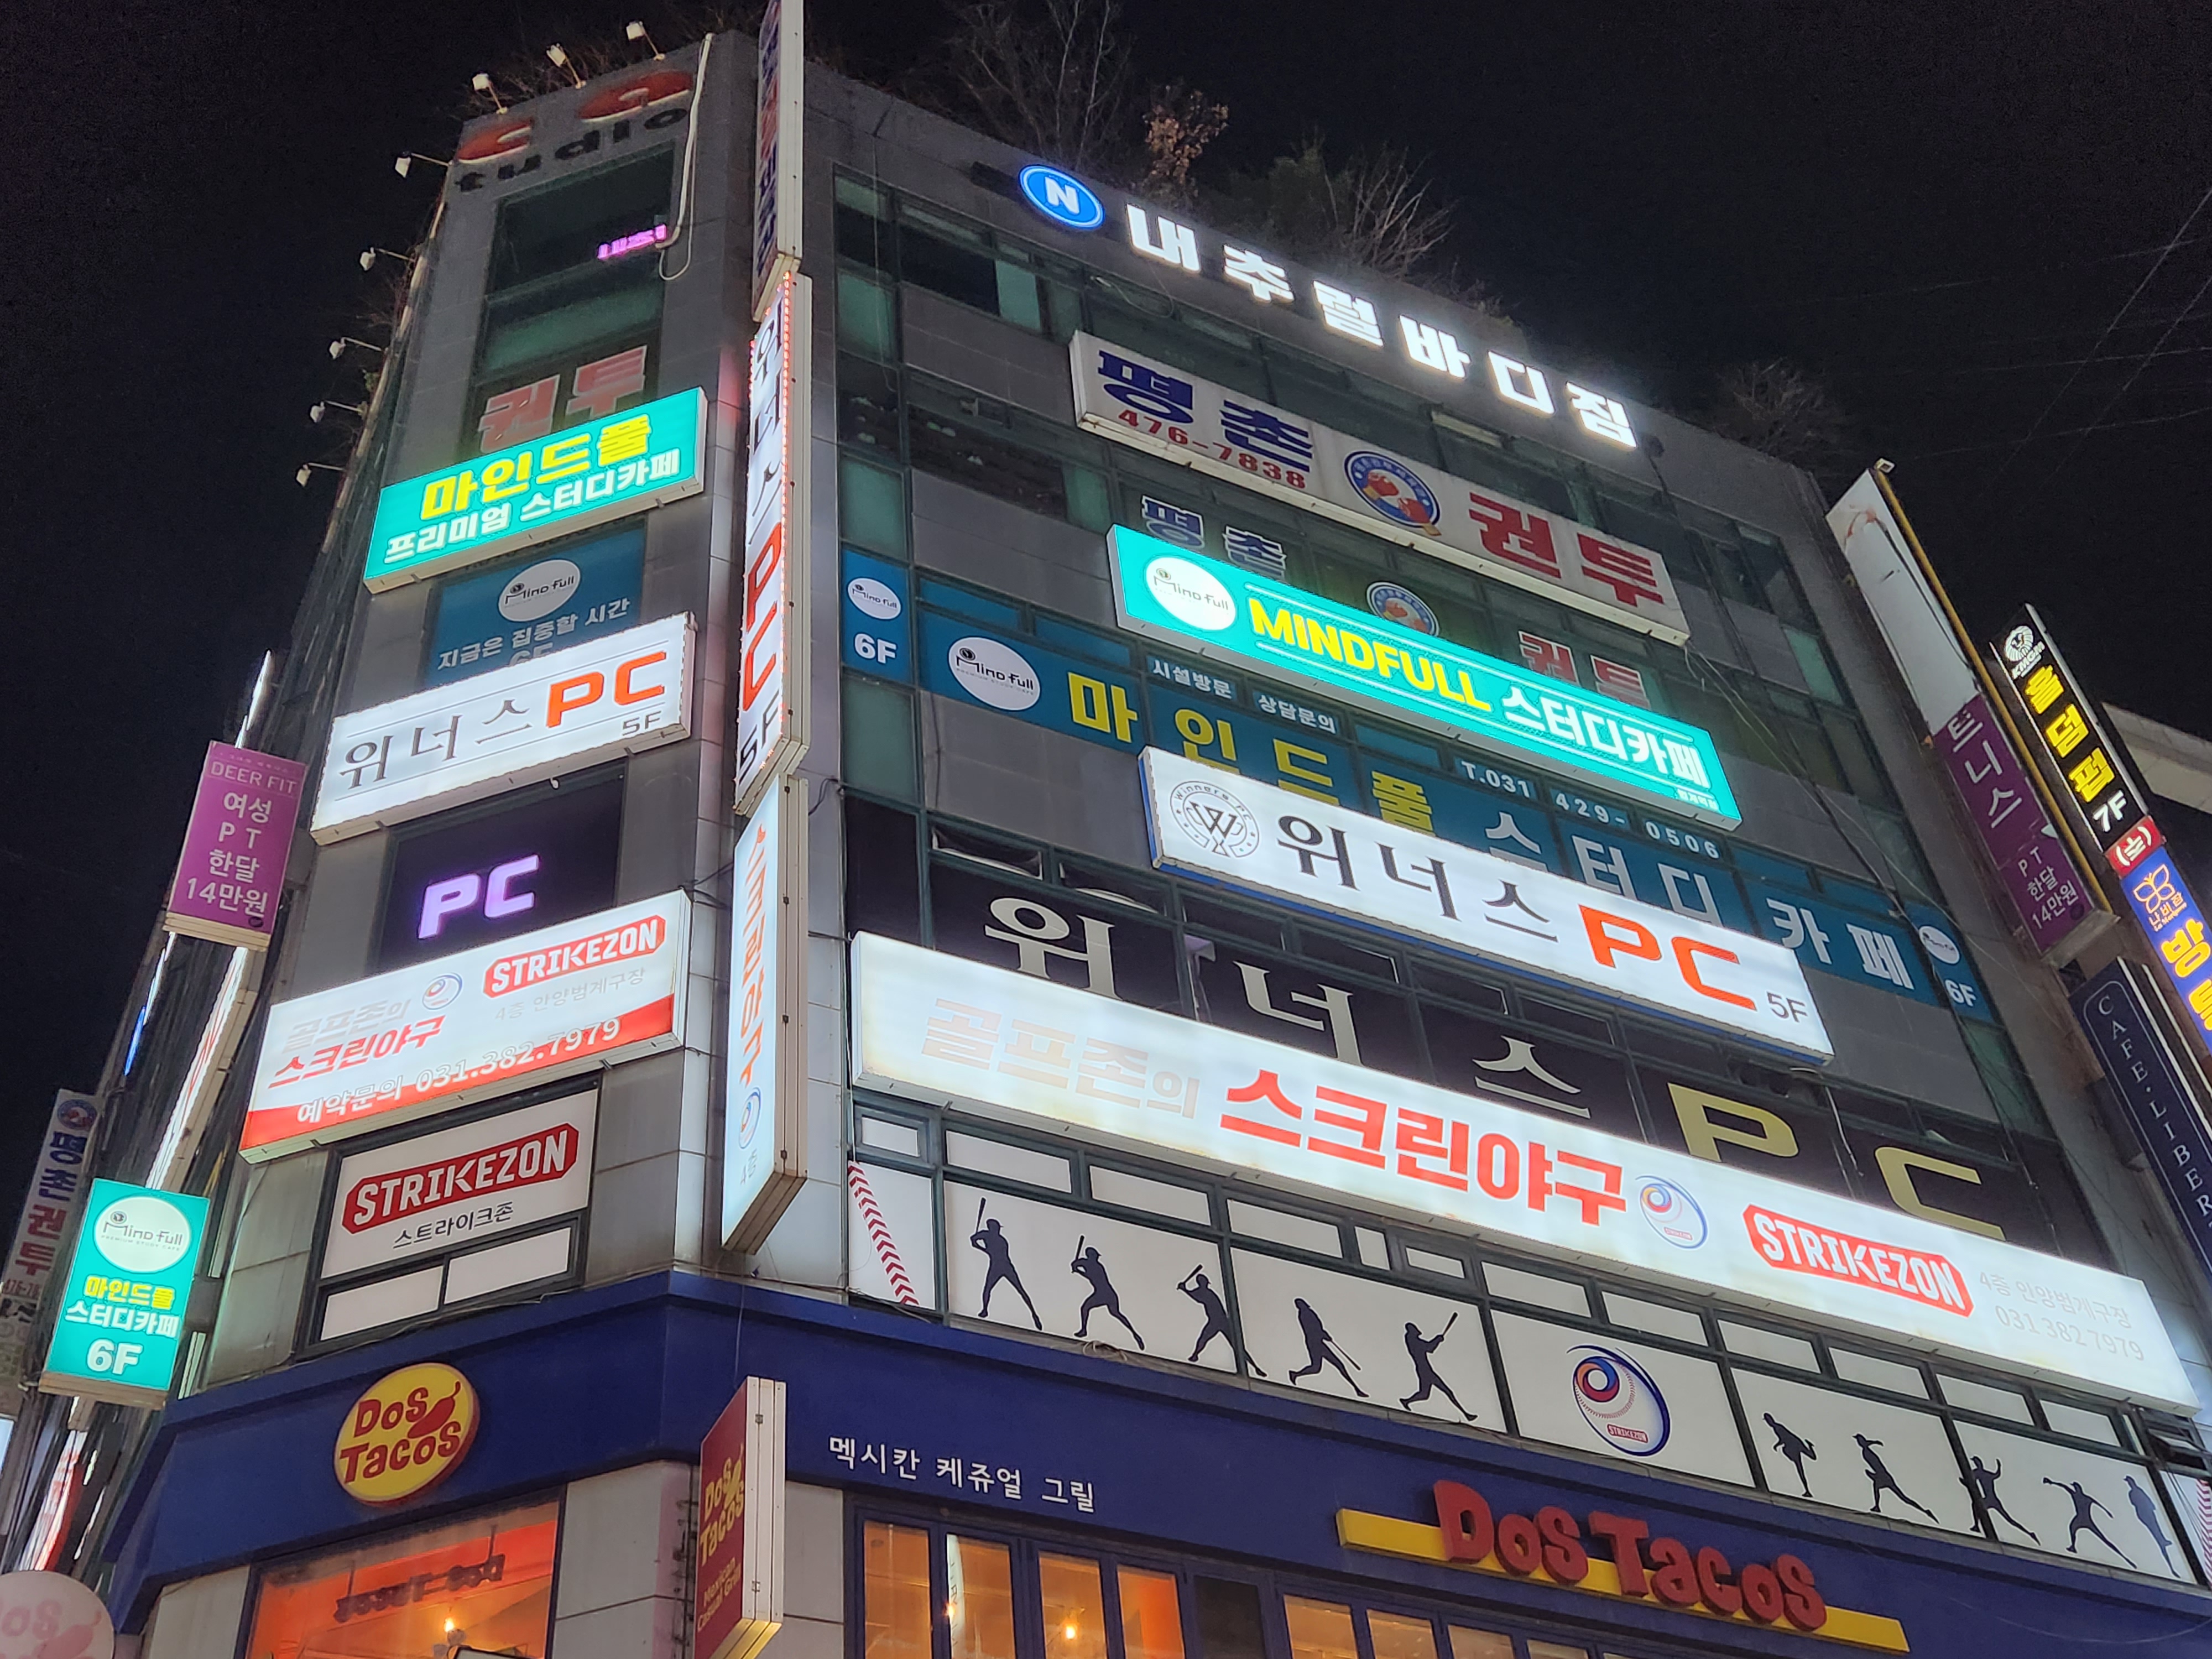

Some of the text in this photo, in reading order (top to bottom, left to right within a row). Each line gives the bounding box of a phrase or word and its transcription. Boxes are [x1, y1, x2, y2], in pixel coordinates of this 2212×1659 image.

[1045, 176, 1079, 215] N
[421, 415, 651, 519] 마인드풀
[1118, 409, 1306, 489] 476-7838
[384, 449, 679, 563] 프리미엄 스터디카페
[1469, 492, 1665, 607] 권투
[437, 598, 630, 670] 지금은 집중할 시간
[855, 633, 896, 664] 6F
[1153, 660, 1337, 734] 시설방문 상담문의
[1249, 598, 1710, 789] MINDFULL 스터디카페
[622, 711, 661, 736] 5F
[2025, 665, 2115, 802] 홀덤펍
[211, 761, 262, 786] DEER
[268, 776, 296, 794] FIT
[223, 793, 272, 823] 여성
[1461, 761, 1531, 797] T.031
[1646, 821, 1720, 859] 0506
[2093, 790, 2128, 832] 7F
[208, 849, 259, 883] 한달
[2027, 866, 2059, 902] 한달
[187, 877, 269, 918] 14만원
[418, 855, 539, 938] PC
[2031, 881, 2079, 930] 14만원
[489, 918, 659, 994] STRIKEZON
[740, 824, 766, 1088] 스크린야구
[495, 968, 645, 1021] 4층 안양범계구장
[1766, 992, 1808, 1023] 5F
[1945, 979, 1976, 1006] 6F
[283, 998, 412, 1052] 골프존의
[268, 1016, 446, 1088] 스크린야구
[297, 1017, 620, 1124] 예약문의 031.382.7979
[353, 1130, 567, 1225] STRIKEZON
[921, 998, 1963, 1311] 골프존의 스크린야구 STRIKEZON
[392, 1202, 513, 1249] 스트라이크존
[84, 1276, 175, 1310] 마인드풀
[1980, 1272, 2011, 1296] 4층
[65, 1301, 179, 1338] 스터디카페
[86, 1339, 143, 1375] 6F
[830, 1436, 1094, 1512] 멕시칸 케쥬얼 그릴
